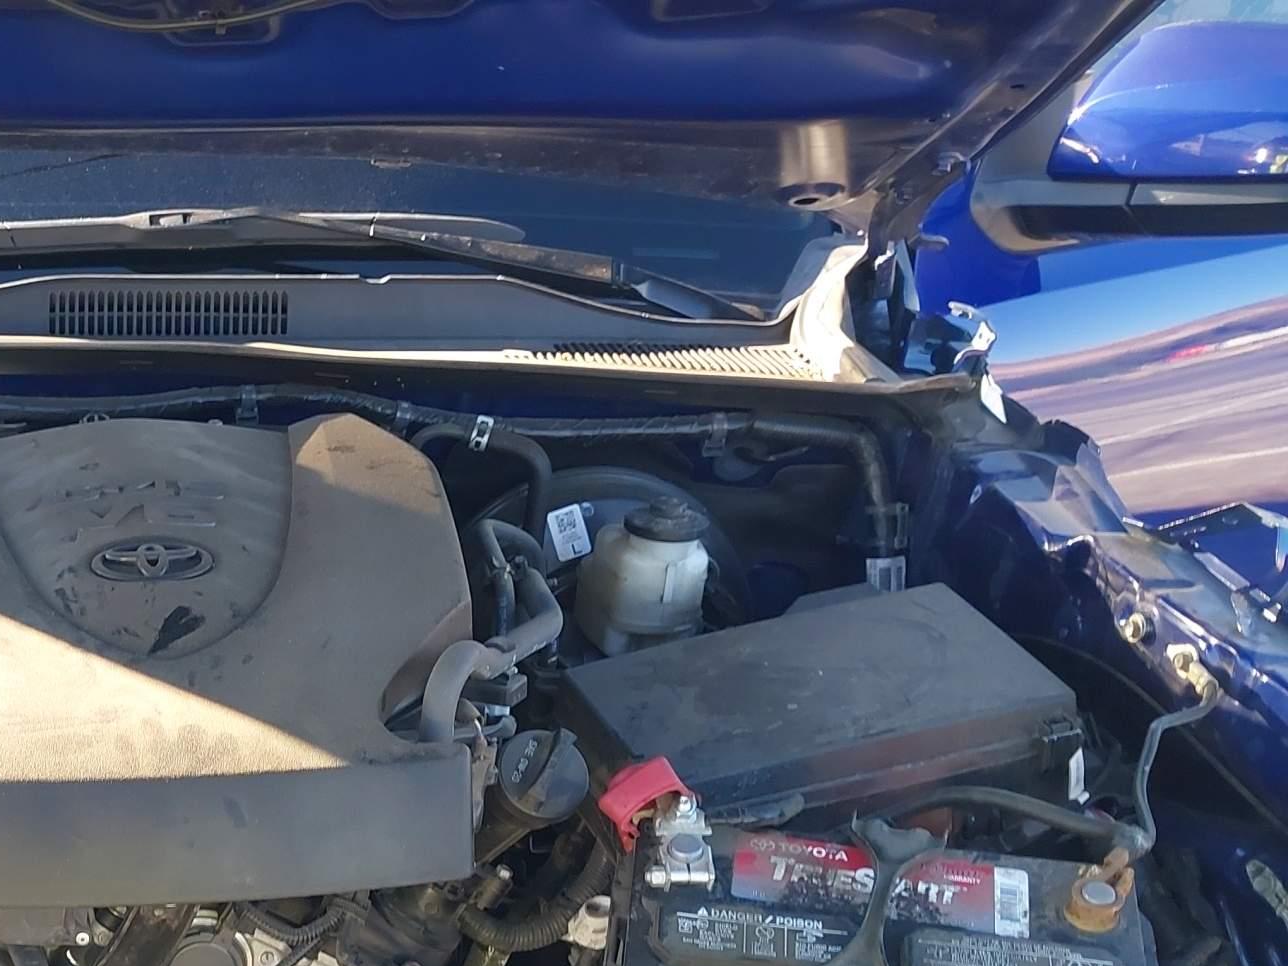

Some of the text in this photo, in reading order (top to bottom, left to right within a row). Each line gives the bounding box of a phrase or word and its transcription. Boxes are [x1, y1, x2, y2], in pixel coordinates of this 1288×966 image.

[572, 543, 583, 556] L
[780, 840, 849, 863] TOYOTA
[710, 907, 762, 923] DANGER
[775, 915, 824, 930] POISON
